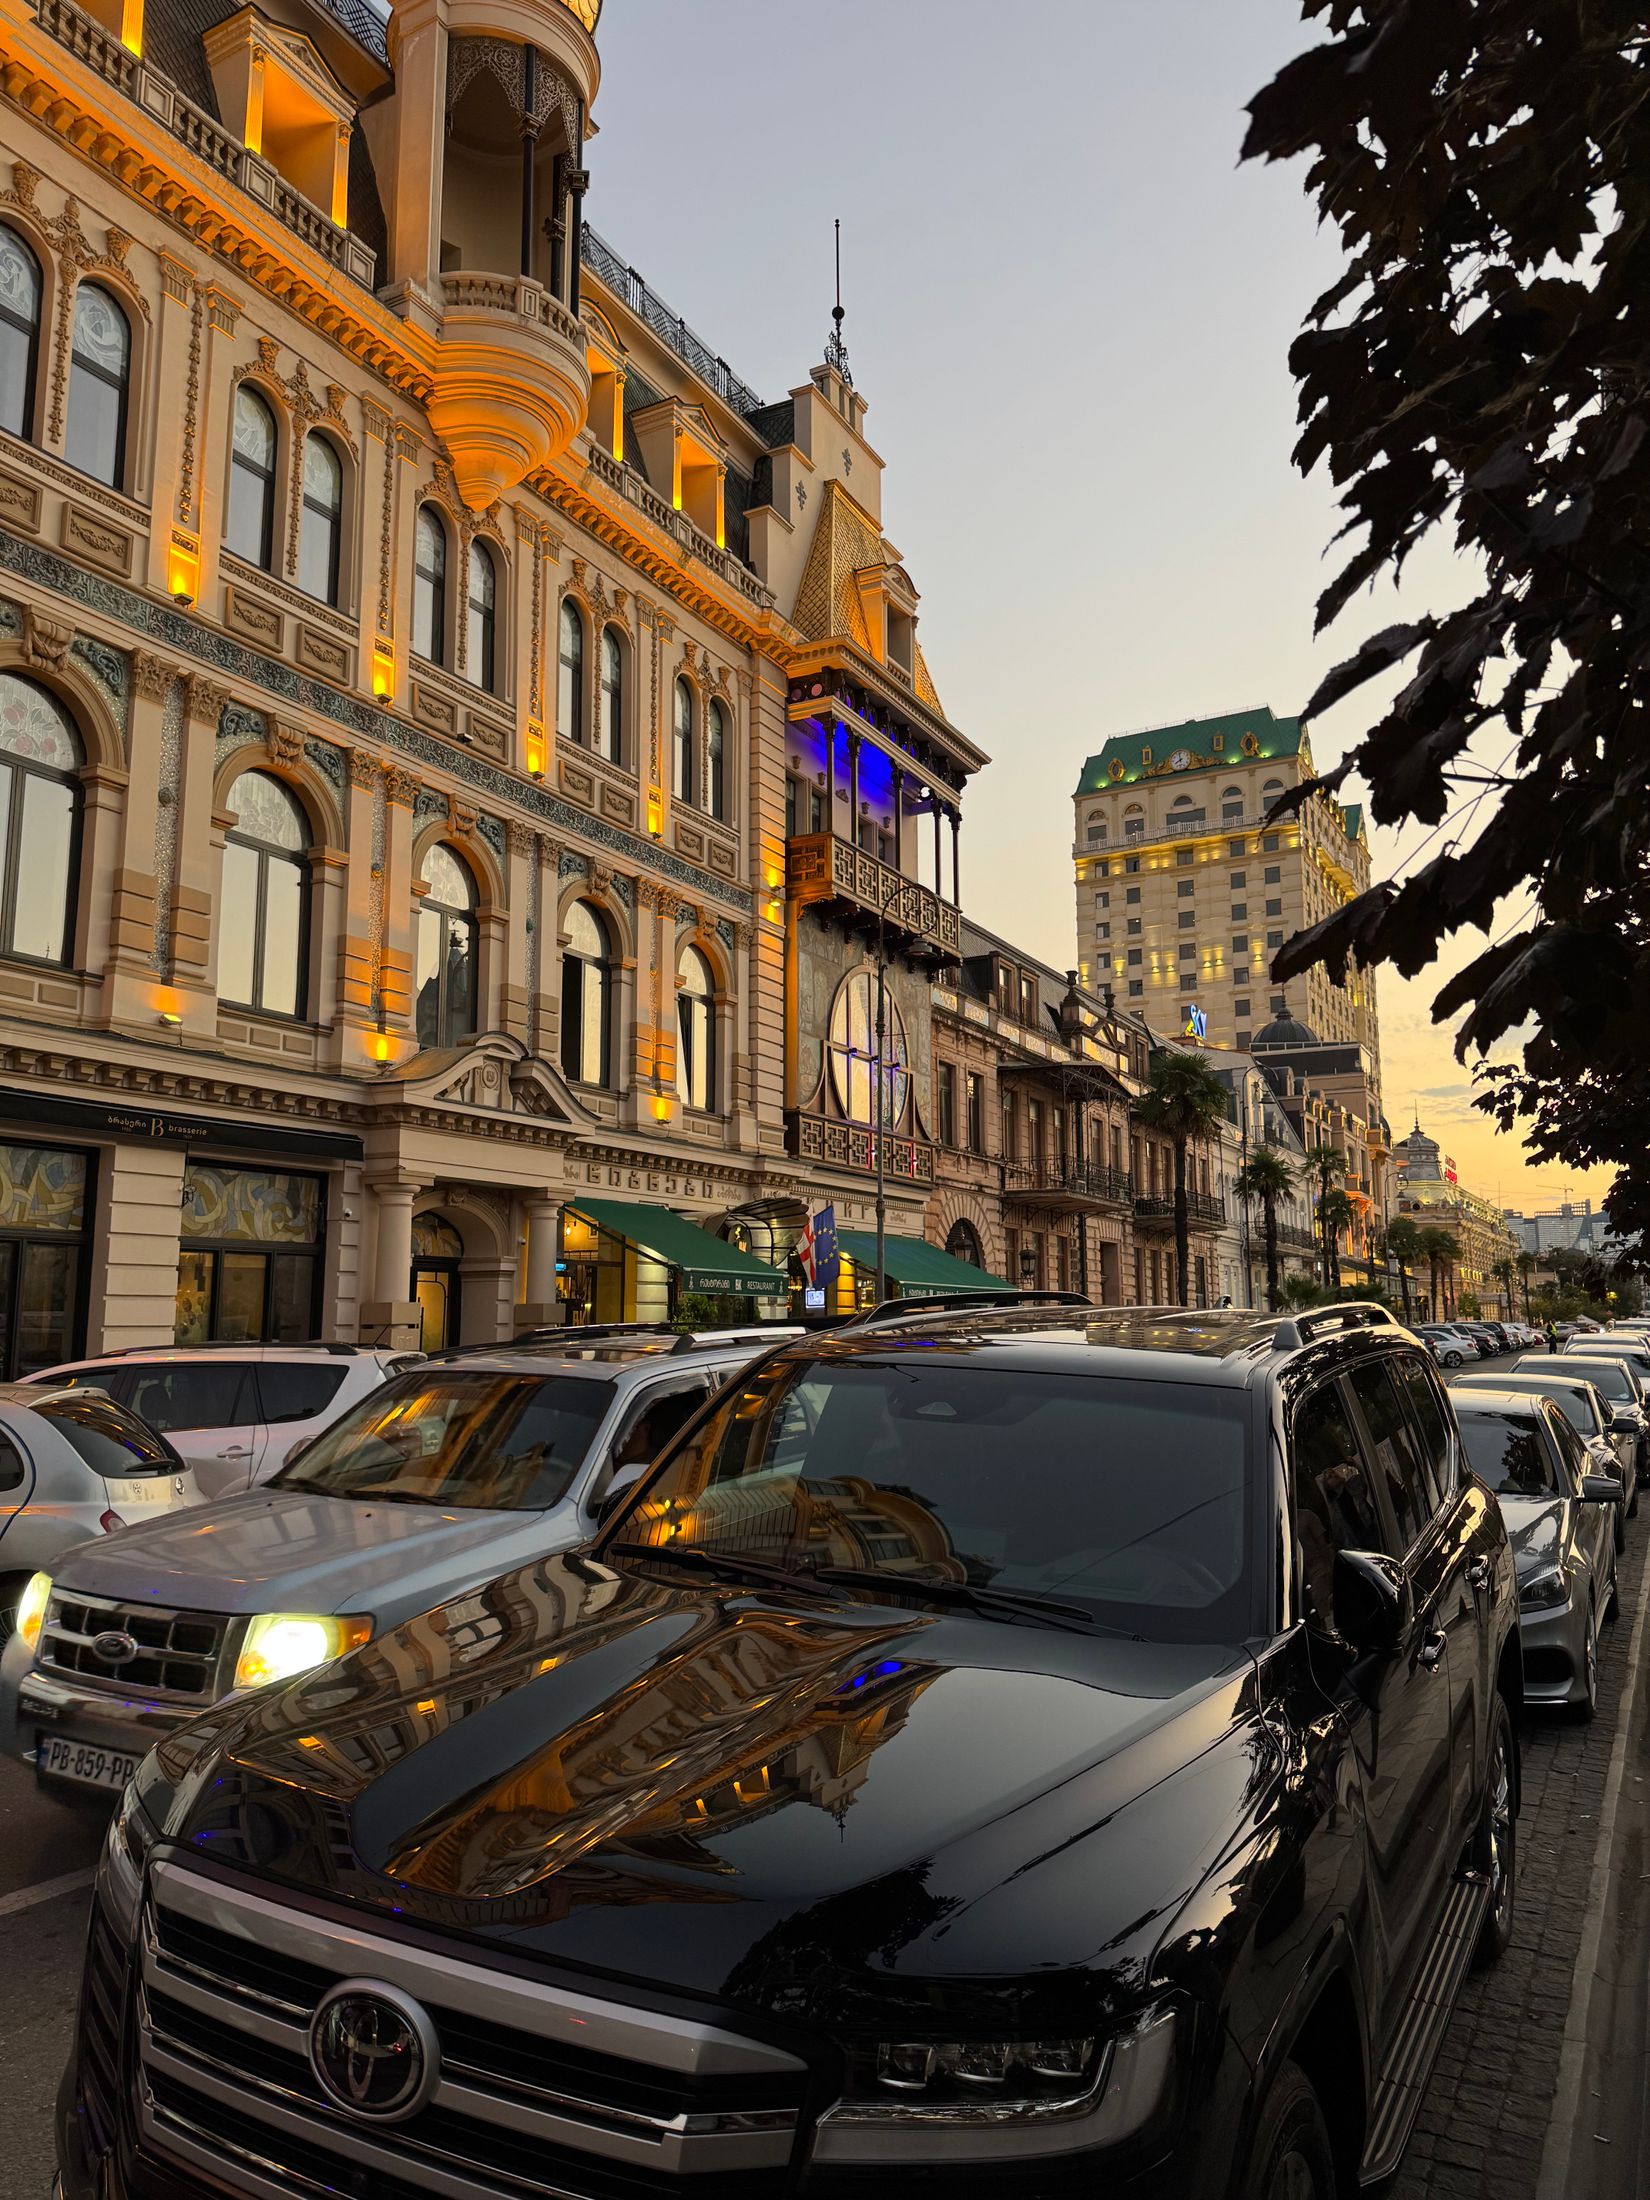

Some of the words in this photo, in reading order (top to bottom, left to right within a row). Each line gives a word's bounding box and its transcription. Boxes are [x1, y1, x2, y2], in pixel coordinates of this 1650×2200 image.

[151, 1118, 164, 1137] B
[168, 1124, 208, 1136] brasserie
[747, 1281, 776, 1291] RESTAURANT
[50, 1742, 134, 1786] PB-859-PP
